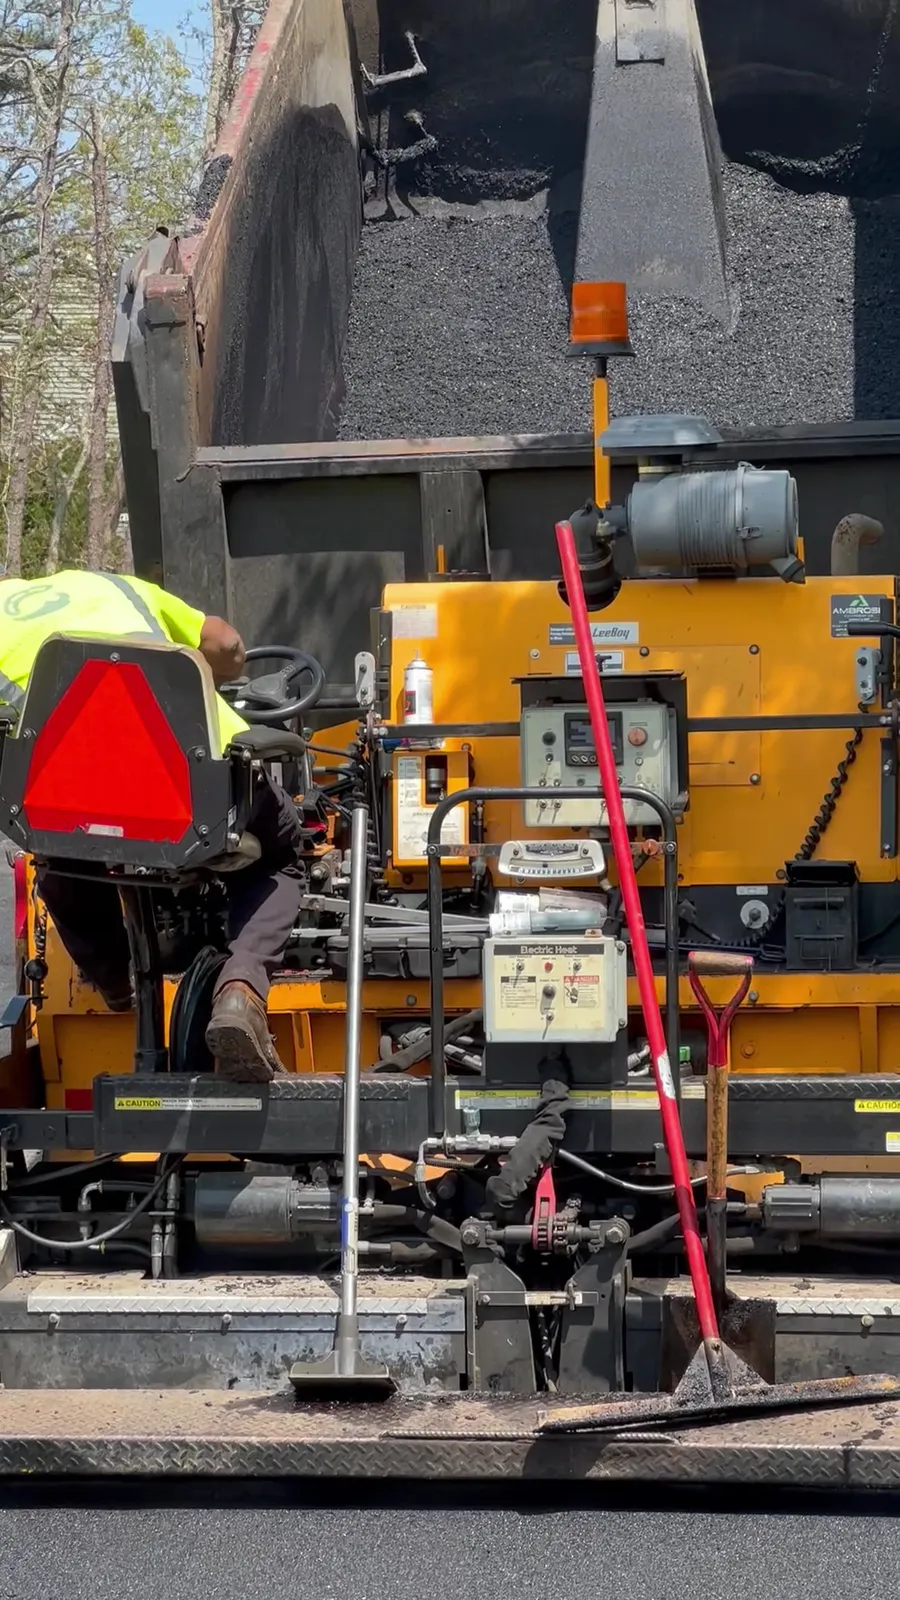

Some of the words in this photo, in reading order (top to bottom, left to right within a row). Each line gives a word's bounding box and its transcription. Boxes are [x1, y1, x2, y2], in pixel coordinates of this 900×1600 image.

[592, 627, 630, 640] LeeBoy
[520, 945, 554, 954] Electric
[555, 945, 578, 954] Heat
